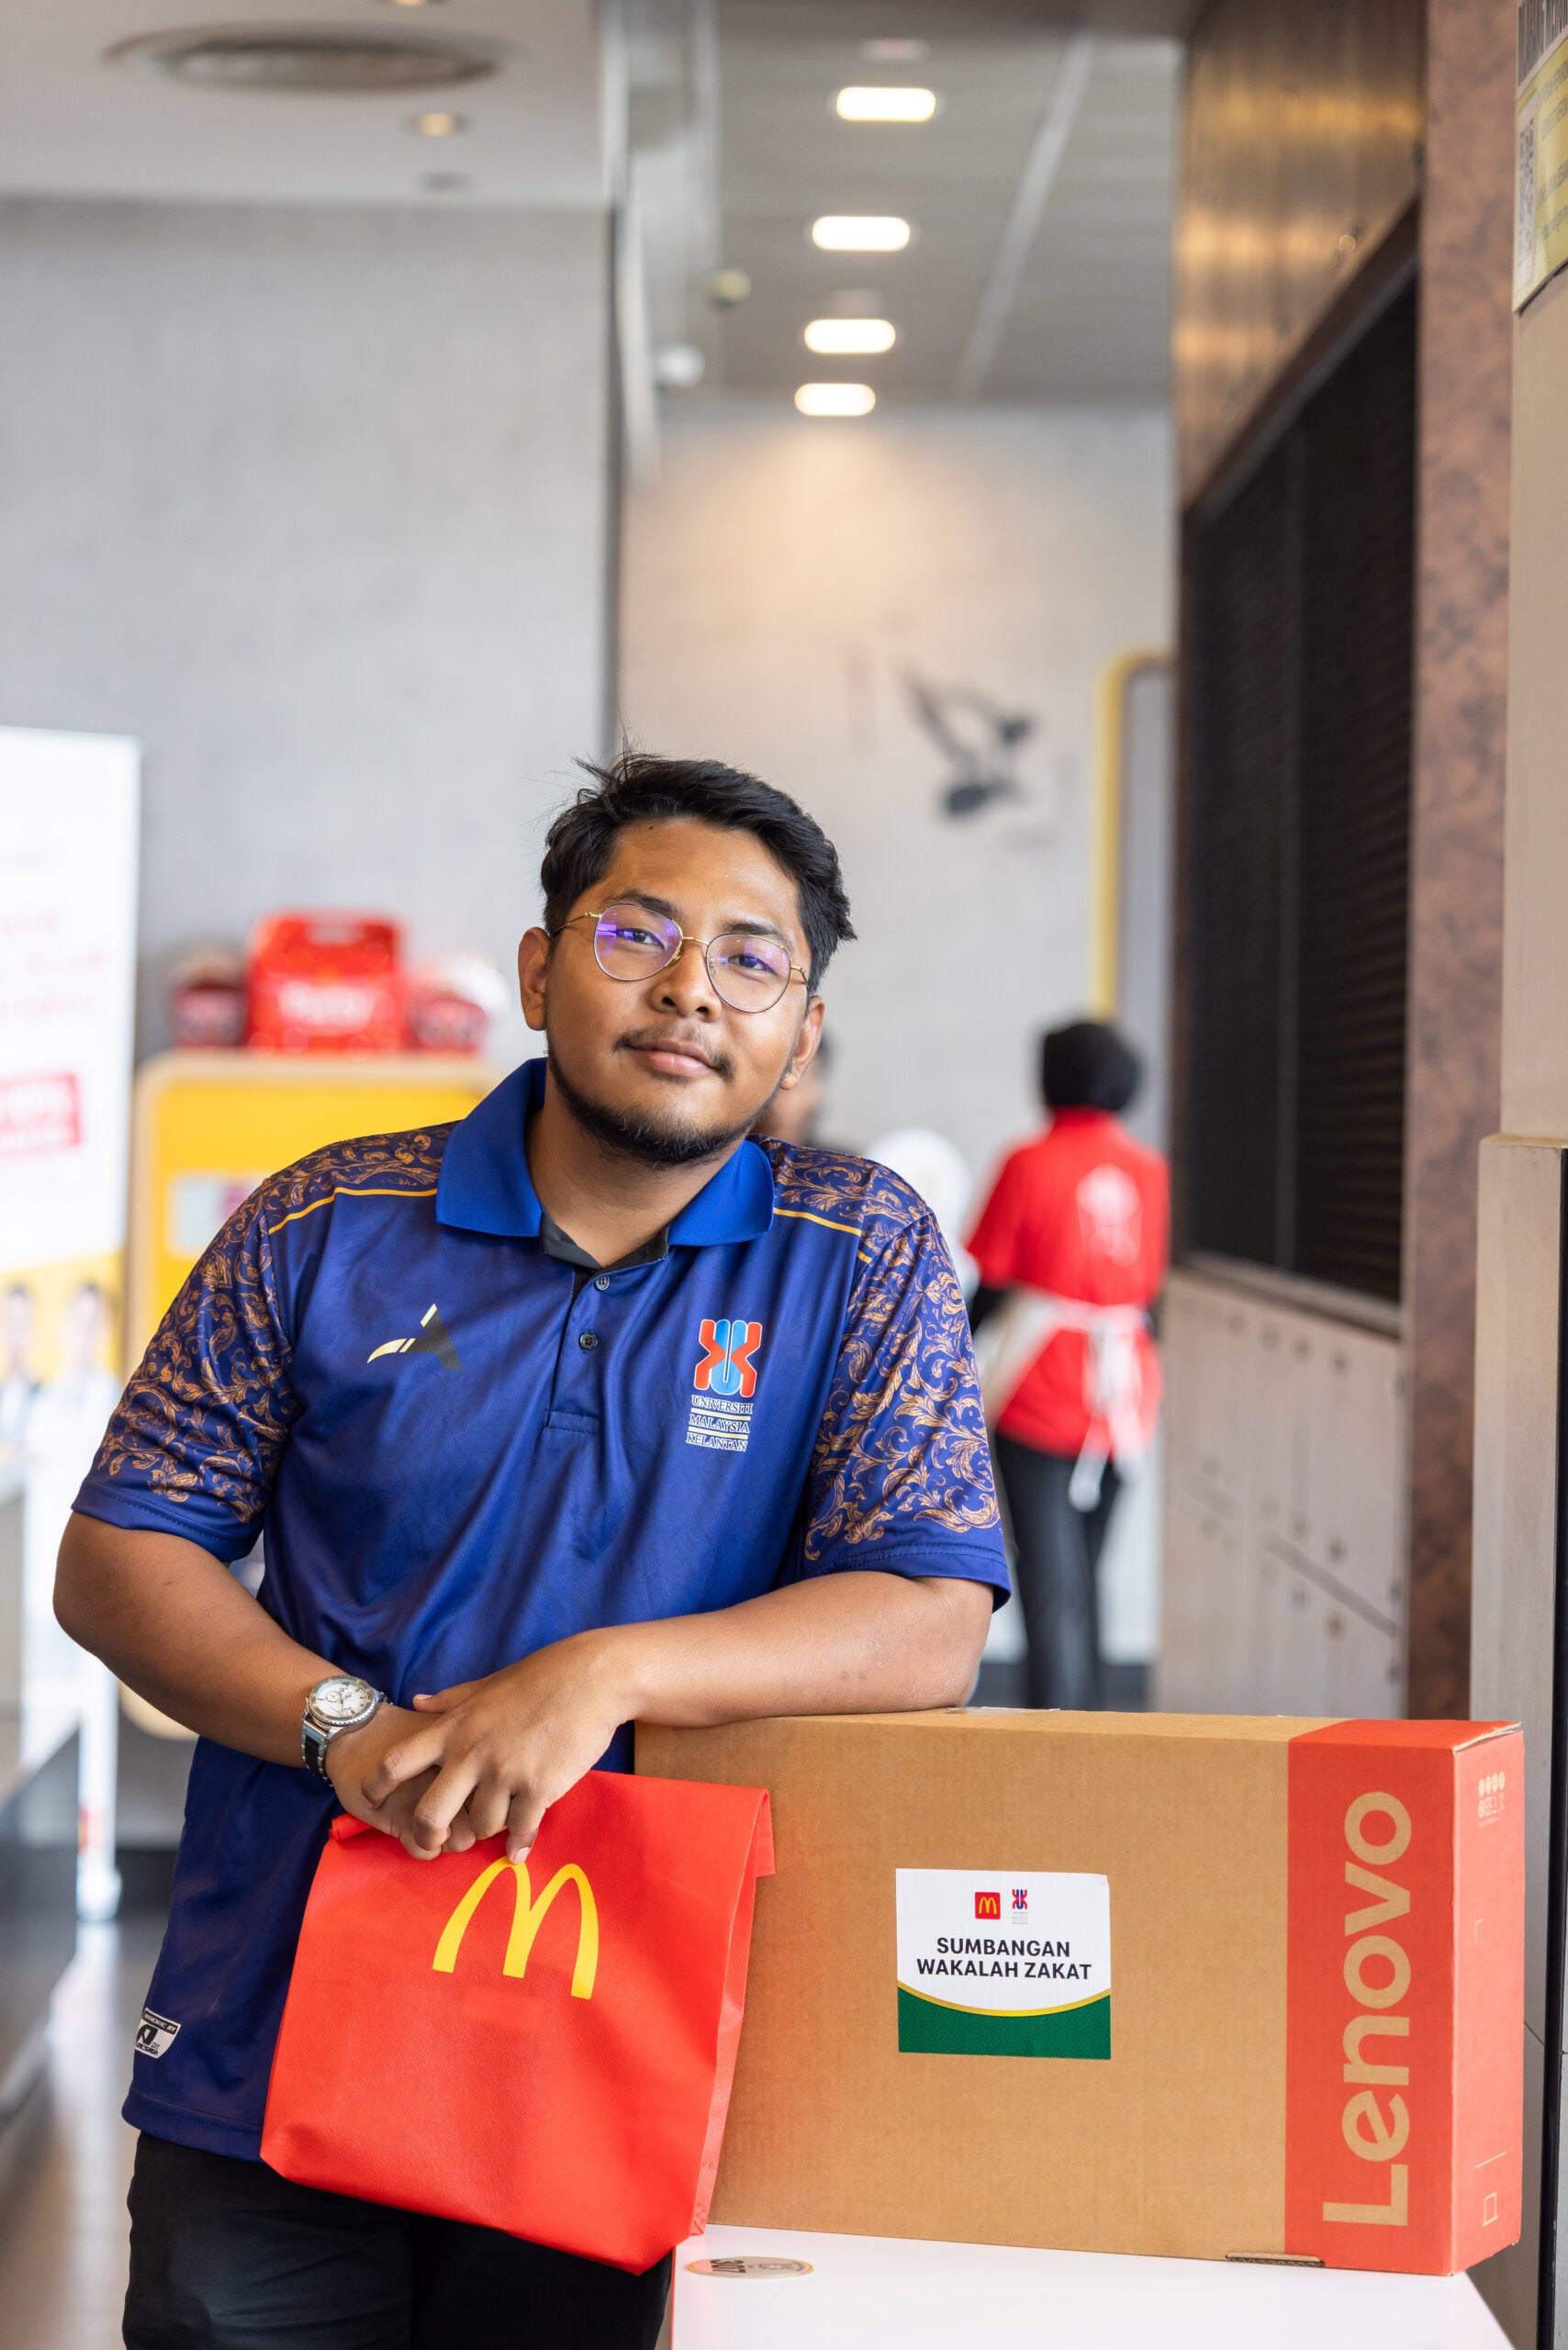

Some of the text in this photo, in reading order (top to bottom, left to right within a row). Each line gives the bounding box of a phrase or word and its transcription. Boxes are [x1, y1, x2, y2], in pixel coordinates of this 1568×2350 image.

[691, 1395, 753, 1415] UNIVERSITI
[689, 1414, 751, 1434] MALAYSIA
[686, 1432, 748, 1452] KELANTAN
[936, 1937, 1070, 1957] SUMBANGAN
[917, 1958, 1092, 1980] WAKALAH ZAKAT
[1322, 1791, 1412, 2226] Lenovo
